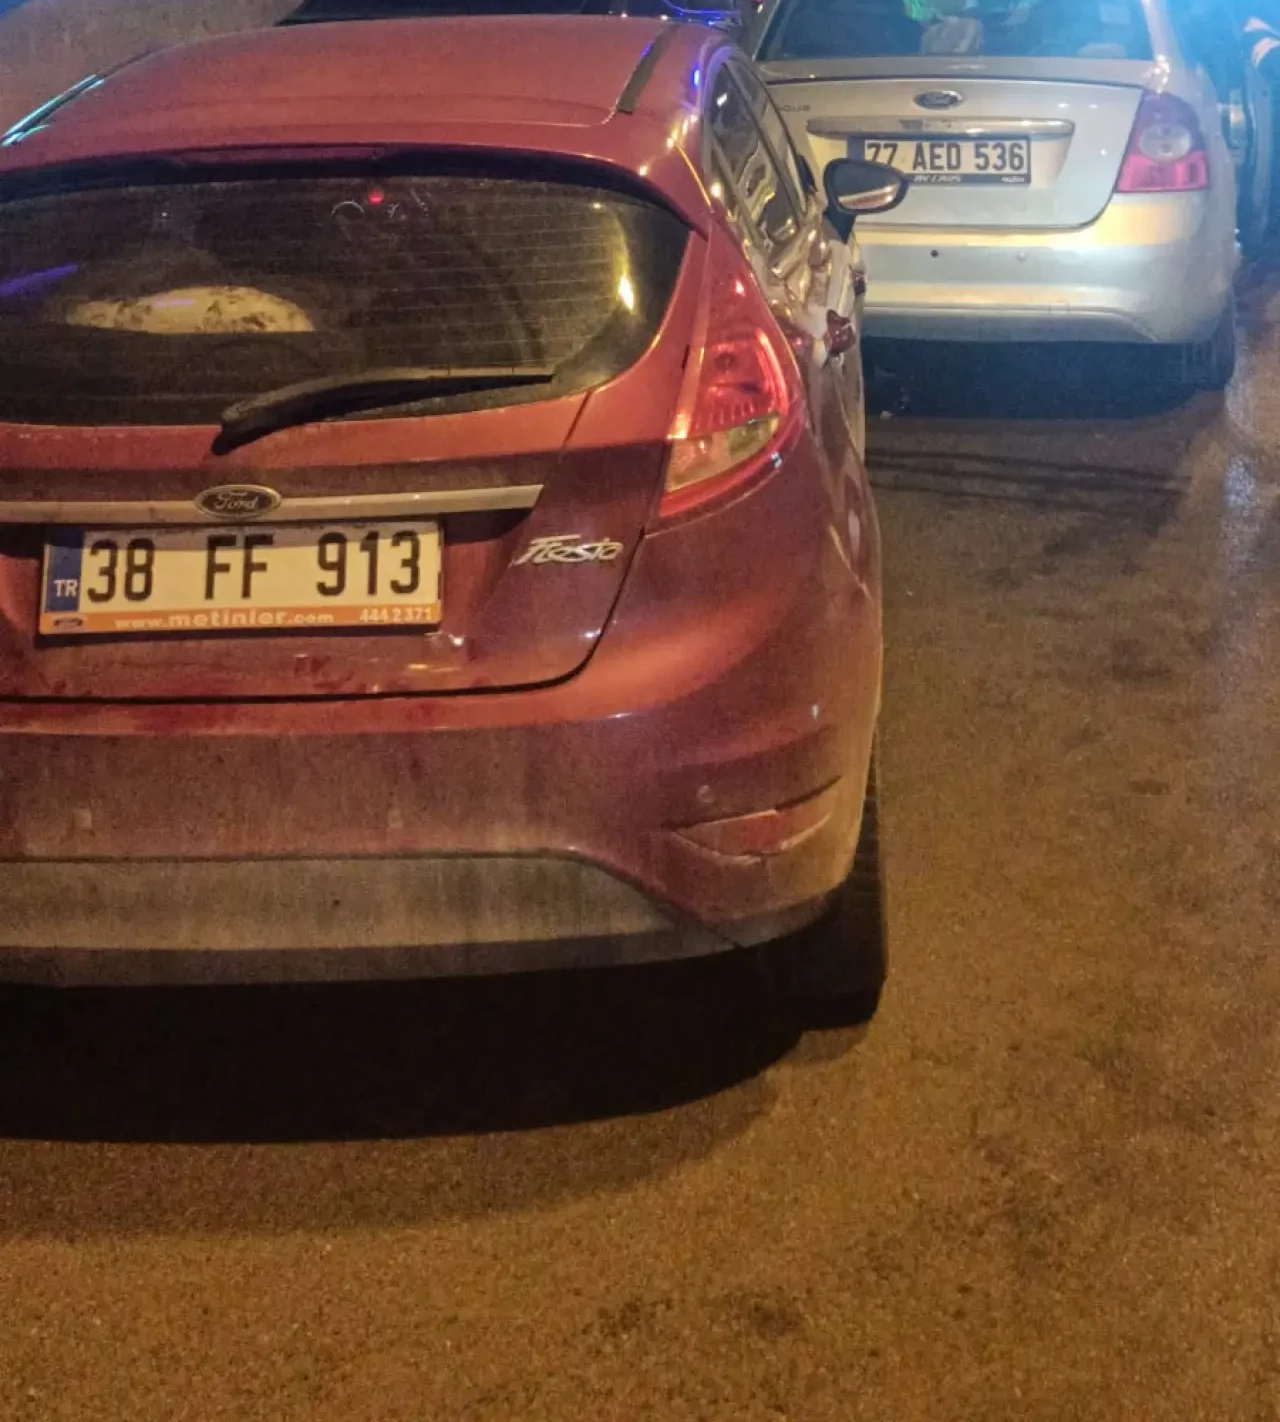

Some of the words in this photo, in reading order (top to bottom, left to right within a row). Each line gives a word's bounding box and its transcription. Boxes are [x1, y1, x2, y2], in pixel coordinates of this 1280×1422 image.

[867, 142, 898, 166] 77
[912, 141, 962, 171] AED
[974, 141, 1025, 171] 536
[213, 491, 259, 510] Ford
[508, 534, 624, 567] Fiesta
[87, 537, 155, 603] 38
[205, 534, 274, 600] FF
[316, 530, 420, 596] 913
[54, 579, 78, 597] TR
